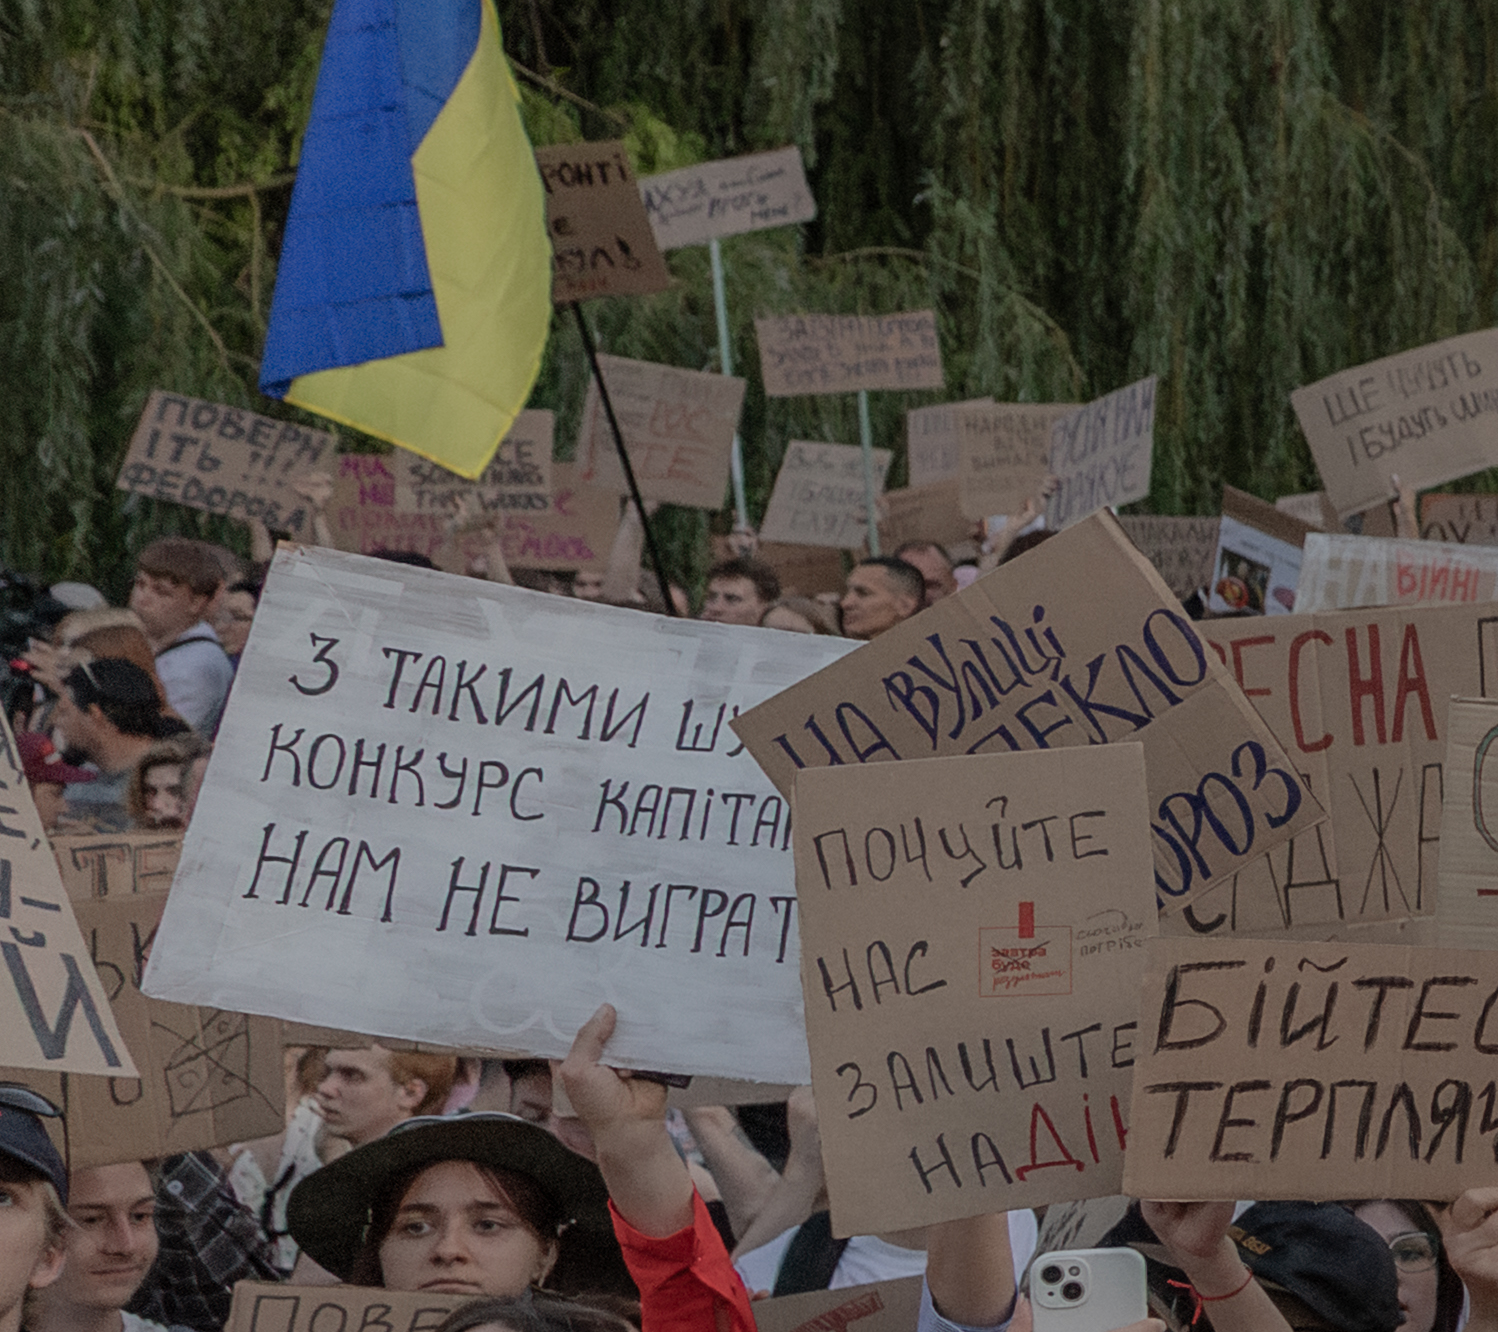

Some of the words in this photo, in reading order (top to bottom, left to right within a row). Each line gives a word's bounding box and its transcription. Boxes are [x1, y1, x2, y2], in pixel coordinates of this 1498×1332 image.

[288, 632, 340, 697] З
[382, 646, 651, 749] ТАКИМИ
[883, 604, 1066, 750] ВУЛИЦІ
[1206, 623, 1438, 755] ЕСНА
[259, 723, 548, 822] КОНКУРС
[242, 823, 402, 924] НАМ
[436, 856, 540, 938] НЕ
[811, 794, 1111, 890] ПОЧУЙТЕ
[815, 939, 948, 1013] НАС
[835, 1020, 1139, 1119] ЗАЛИШТЕ
